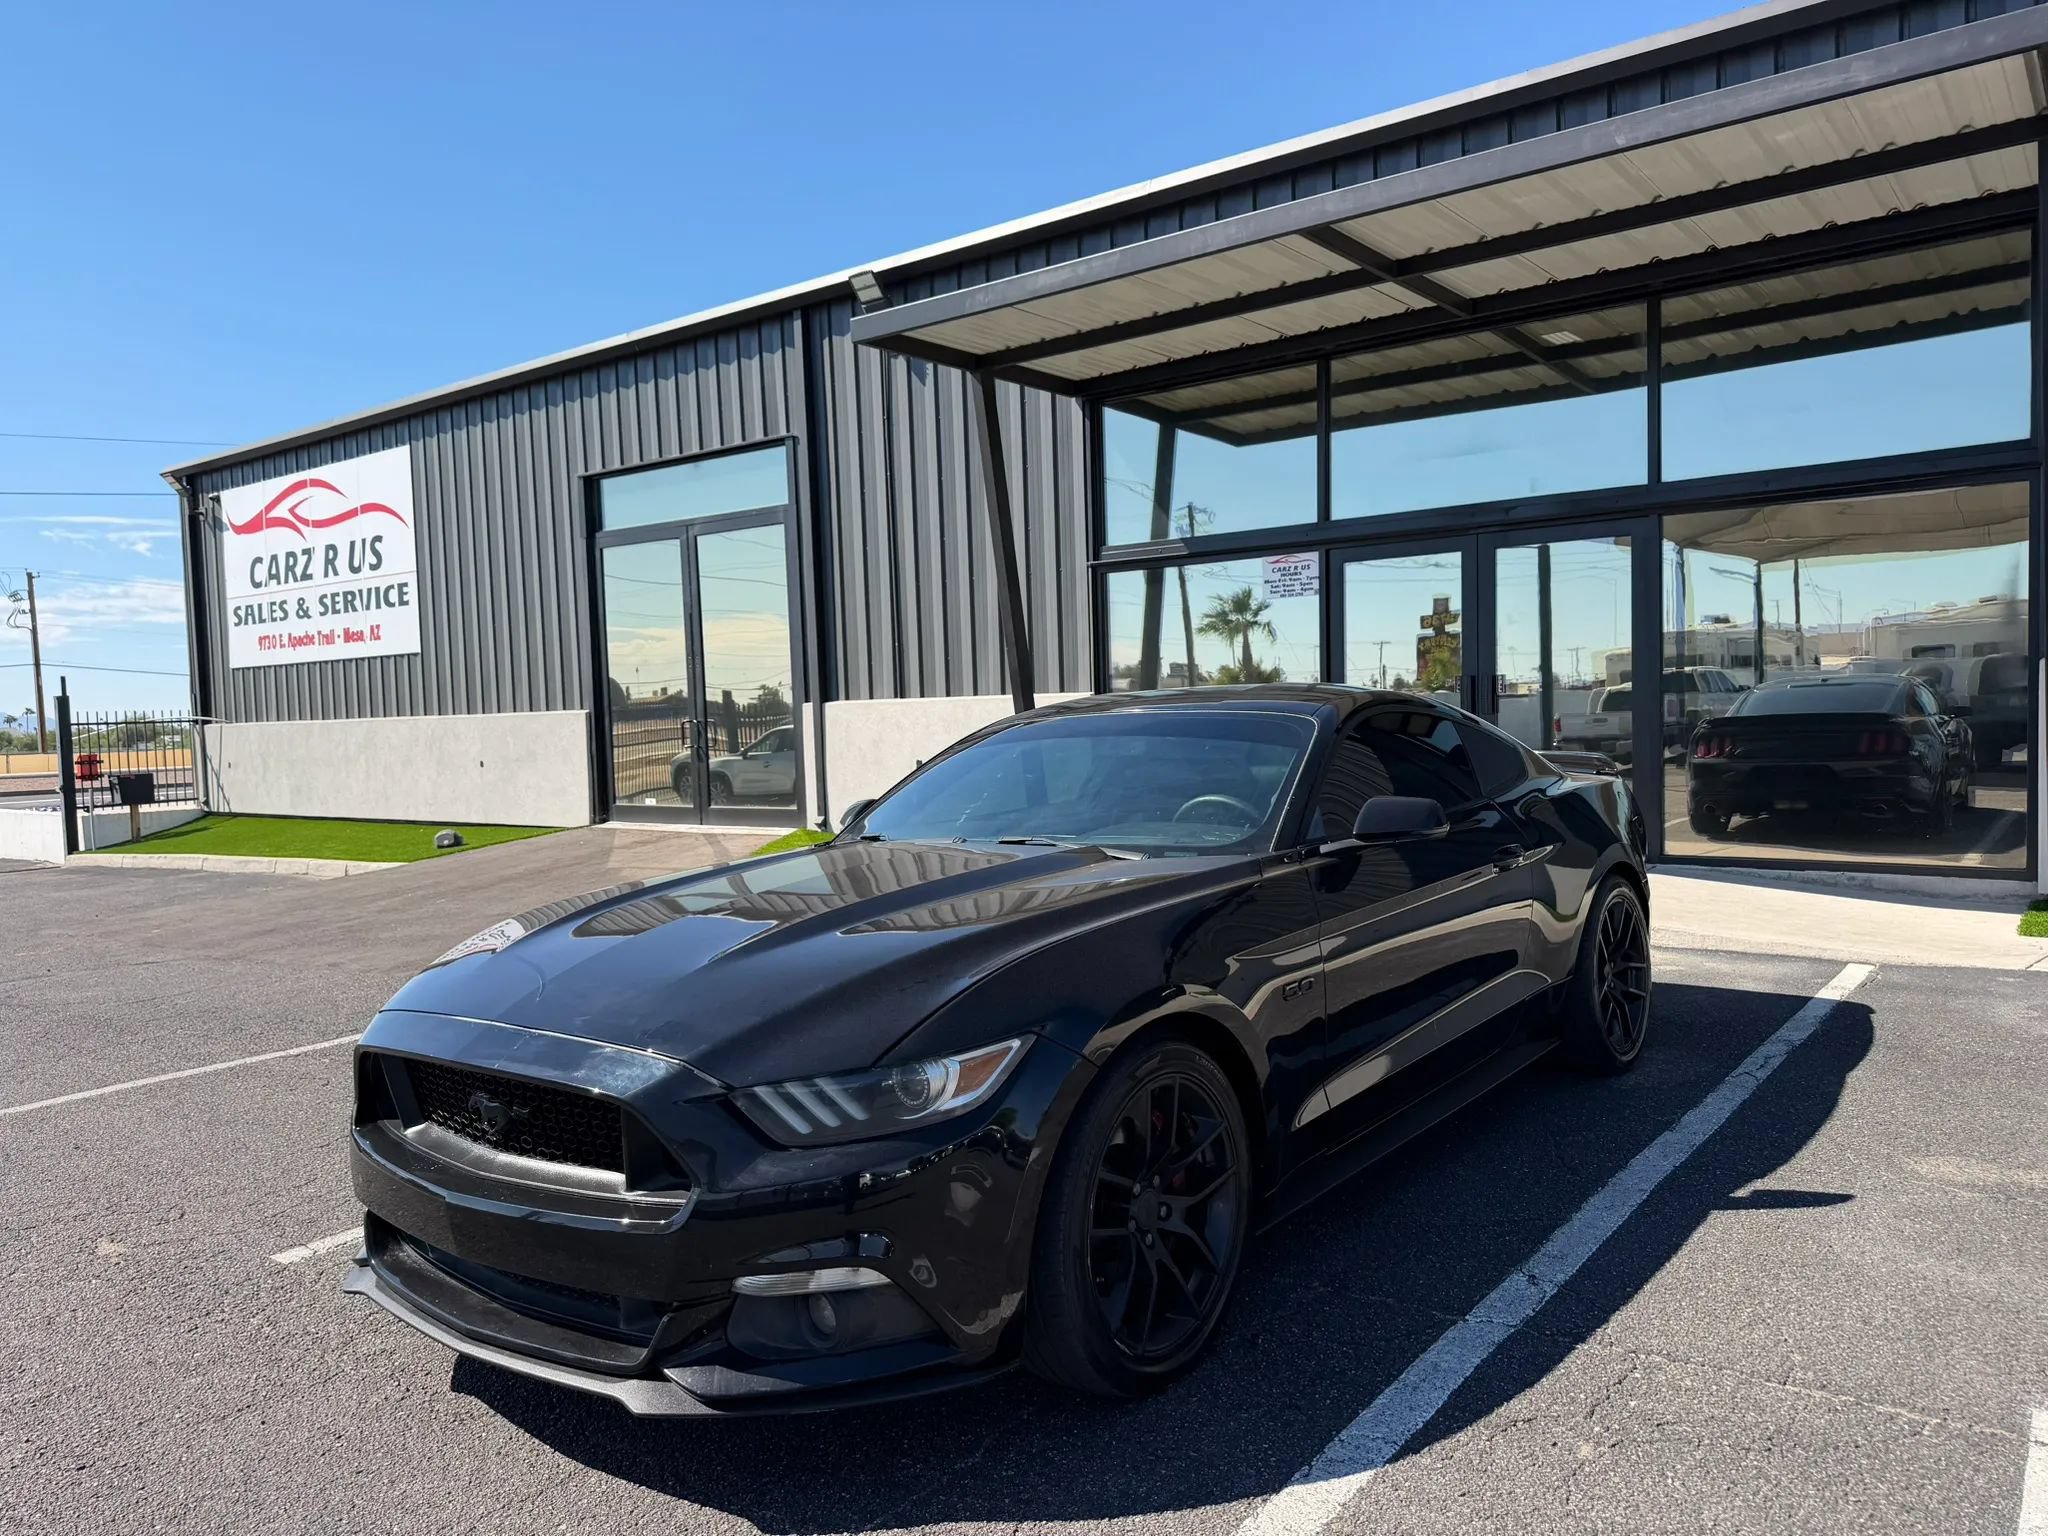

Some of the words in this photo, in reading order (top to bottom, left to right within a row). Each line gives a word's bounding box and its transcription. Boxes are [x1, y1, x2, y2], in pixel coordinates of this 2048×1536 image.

[249, 546, 316, 589] CARZ
[323, 543, 340, 578] R
[349, 534, 384, 574] US
[232, 599, 289, 627] SALES
[295, 597, 313, 620] &
[318, 582, 410, 617] SERVICE
[258, 634, 277, 651] 9730
[279, 633, 286, 649] E.
[287, 631, 315, 651] Apache
[317, 629, 336, 646] Trail
[370, 624, 382, 641] AZ
